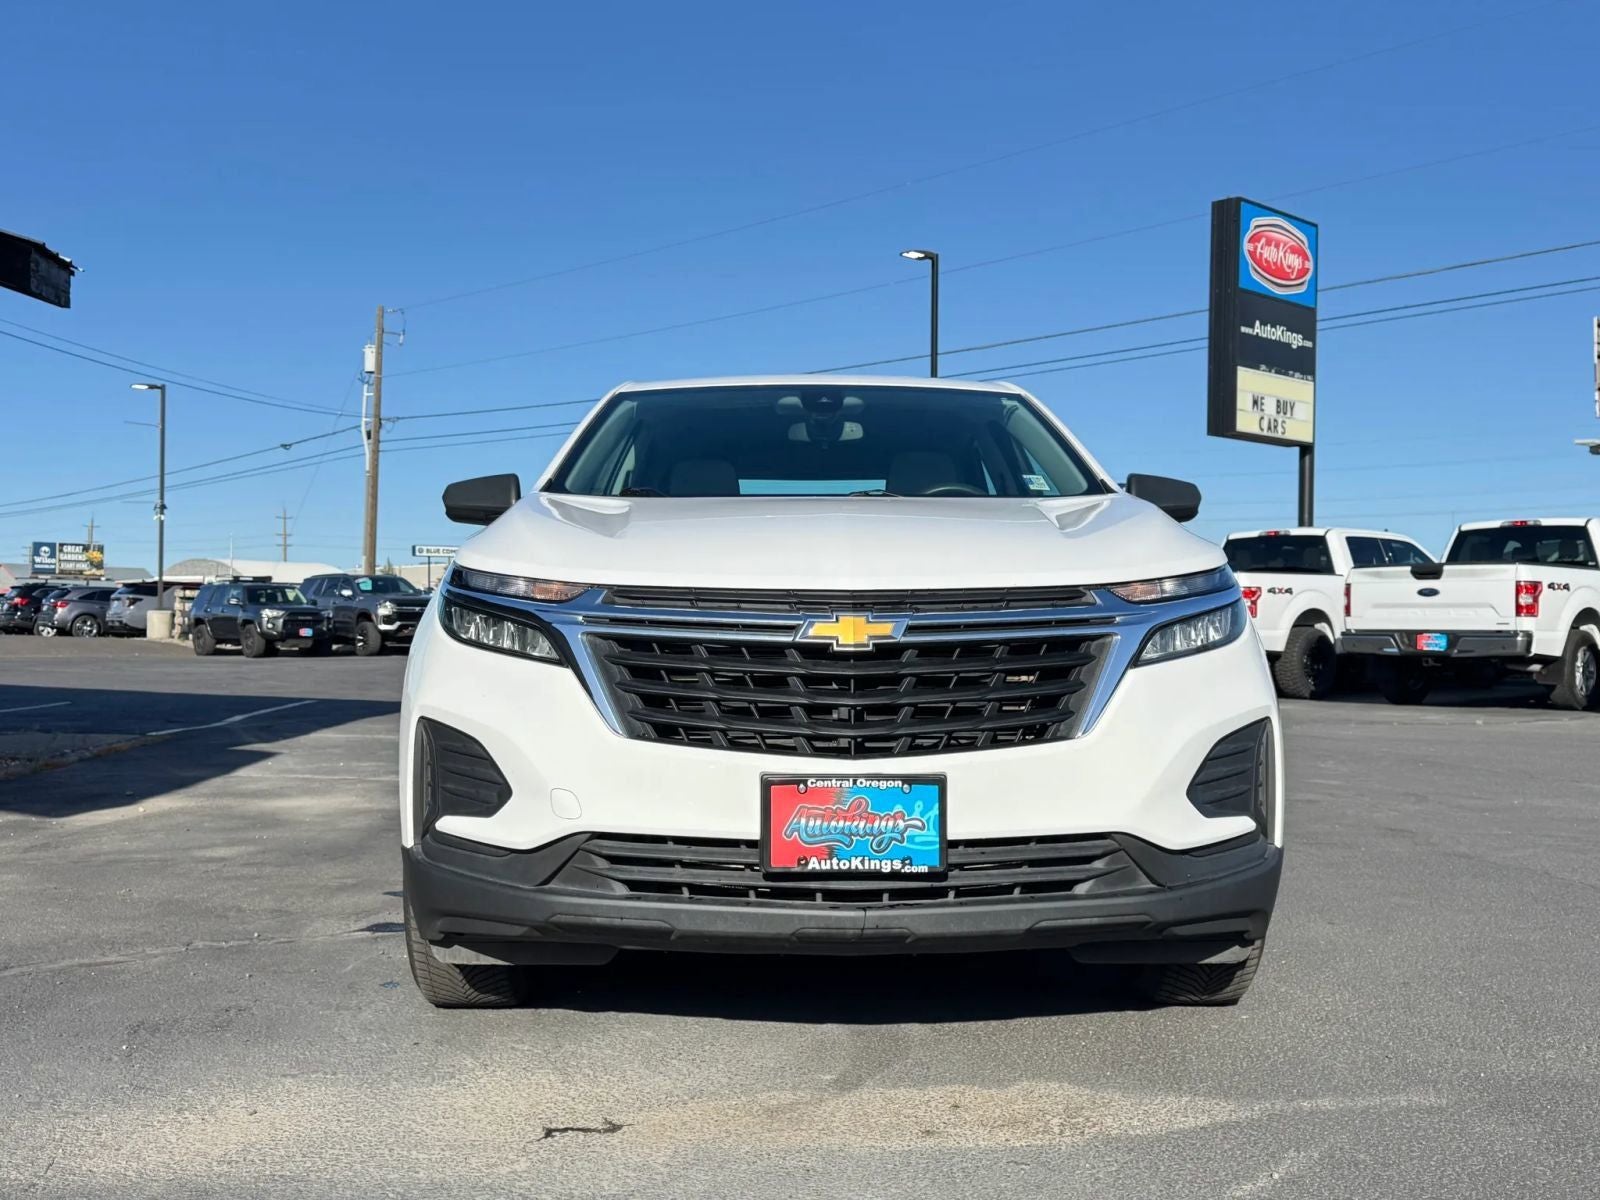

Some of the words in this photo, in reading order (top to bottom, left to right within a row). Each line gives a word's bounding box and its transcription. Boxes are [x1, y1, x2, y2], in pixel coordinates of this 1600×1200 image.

[1252, 395, 1265, 412] WE
[1276, 400, 1295, 417] BUY
[1259, 417, 1286, 435] CARS
[807, 778, 854, 788] Central
[856, 778, 902, 788] Oregon
[808, 856, 928, 873] AutoKings.com
